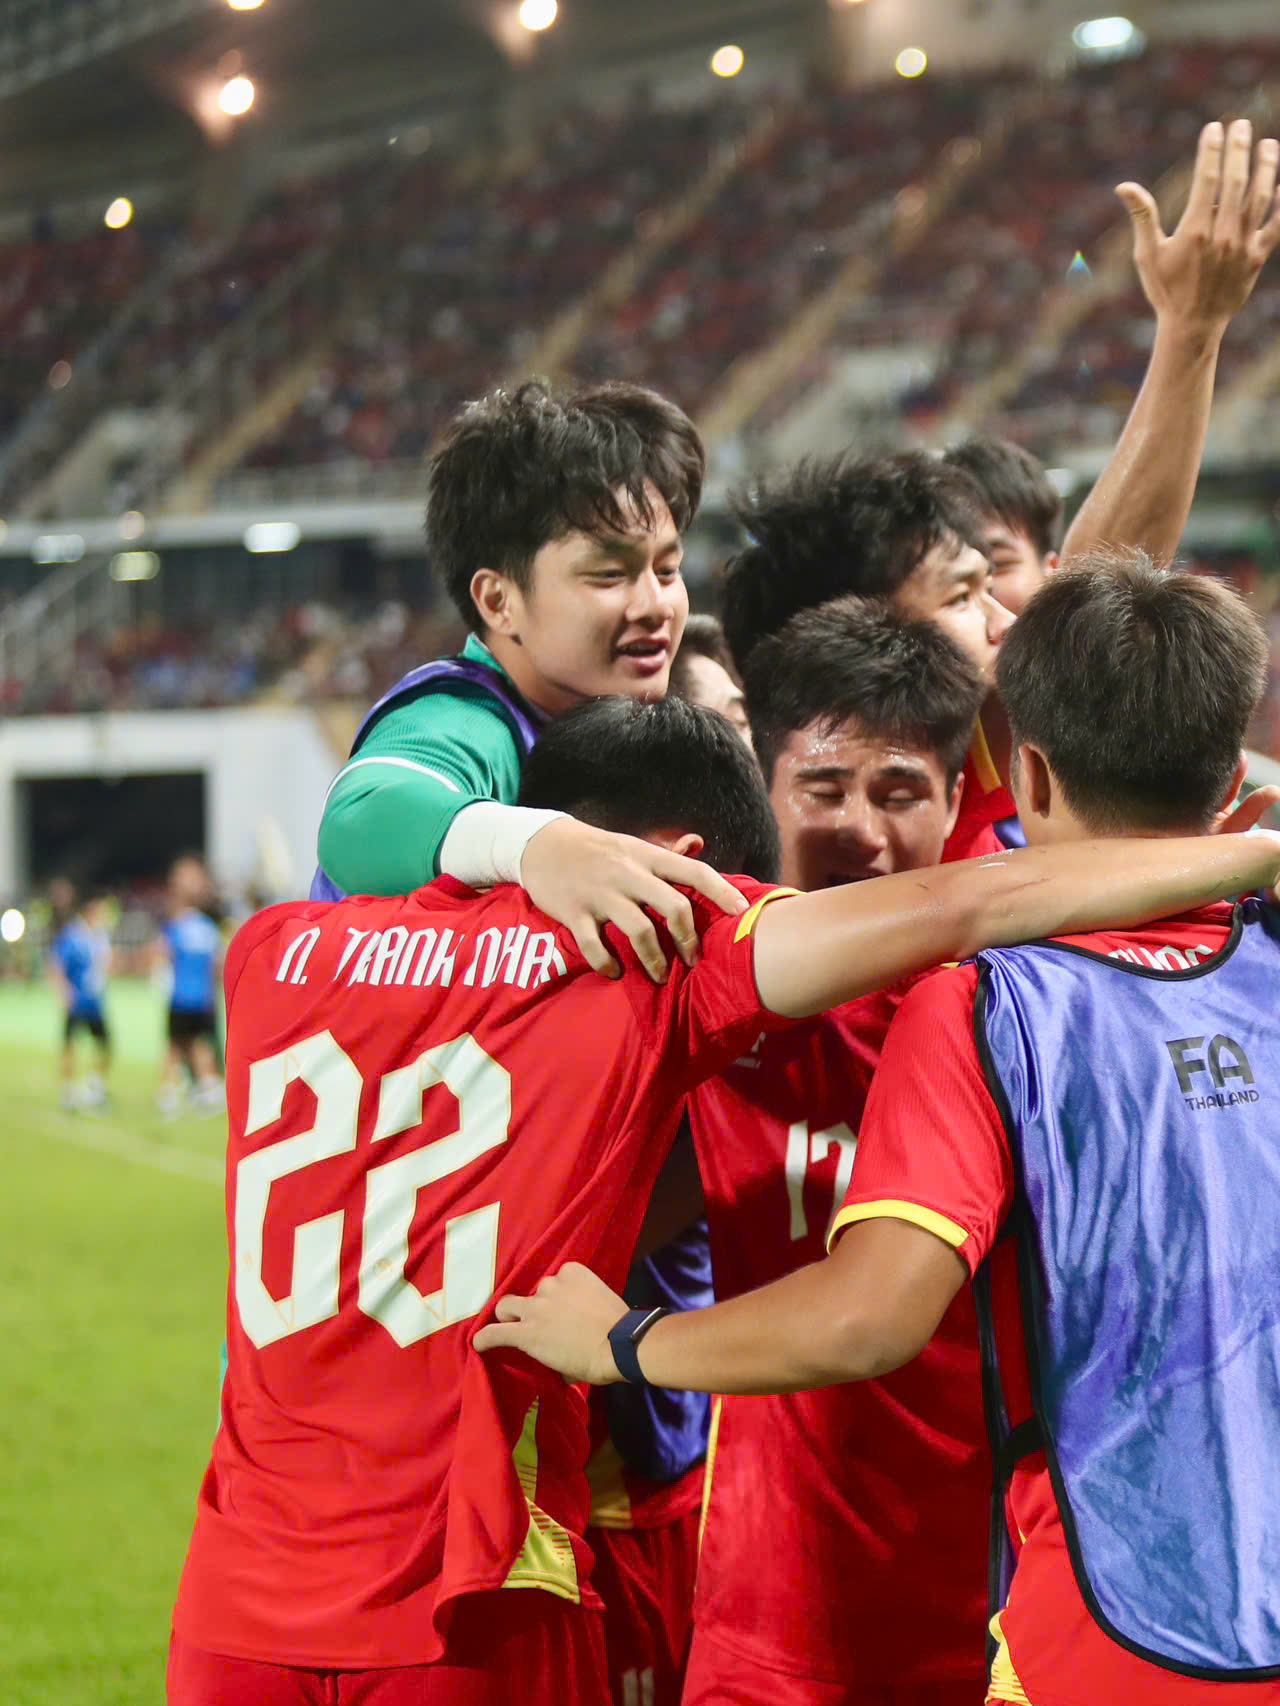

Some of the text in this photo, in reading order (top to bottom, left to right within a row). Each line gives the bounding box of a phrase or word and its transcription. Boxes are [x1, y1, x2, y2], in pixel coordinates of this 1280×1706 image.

[1165, 1033, 1256, 1094] FA
[1184, 1089, 1260, 1112] THAILAND
[234, 1029, 513, 1350] 22
[785, 1119, 859, 1246] 17
